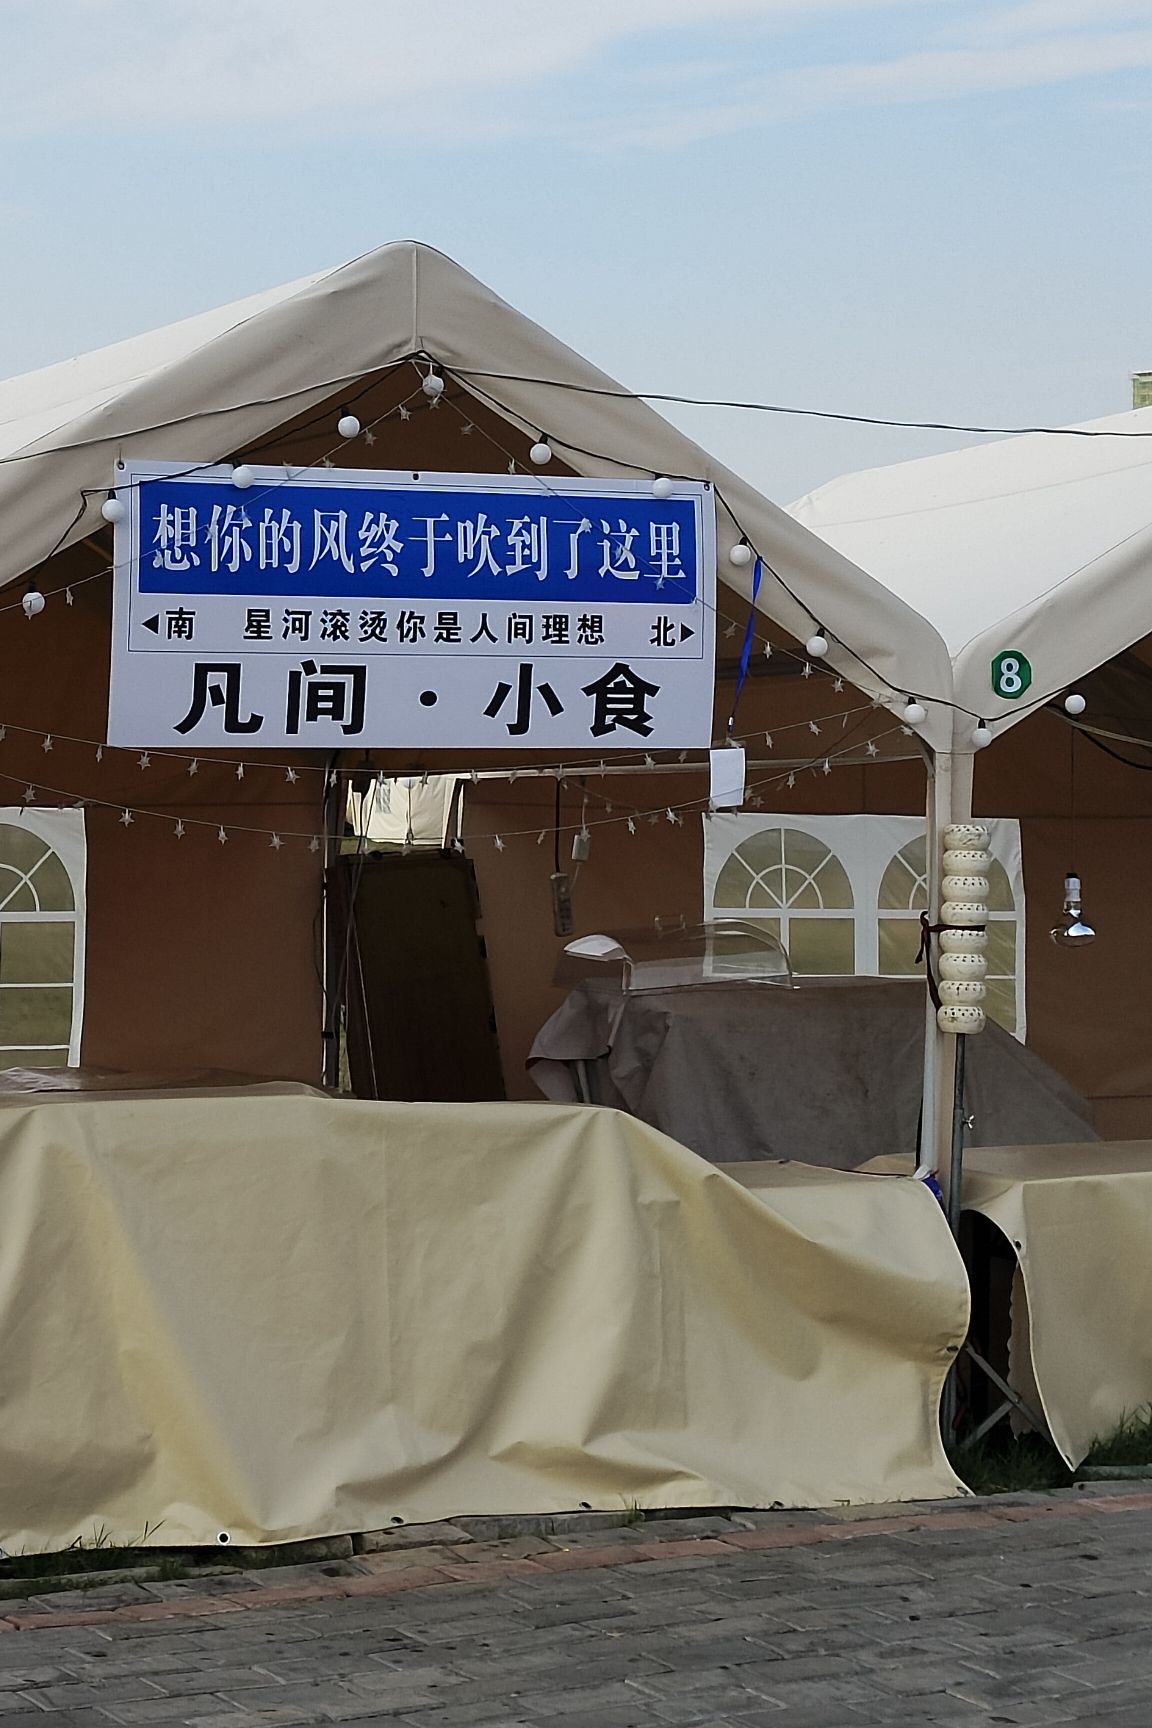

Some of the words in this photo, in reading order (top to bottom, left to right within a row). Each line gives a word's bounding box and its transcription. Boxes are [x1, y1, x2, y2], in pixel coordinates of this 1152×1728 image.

[152, 503, 686, 581] 想你的风终于吹到了这里
[165, 607, 196, 641] 南
[243, 608, 605, 646] 星河滚烫你是人间理想
[650, 616, 676, 647] 北
[999, 658, 1022, 693] 8
